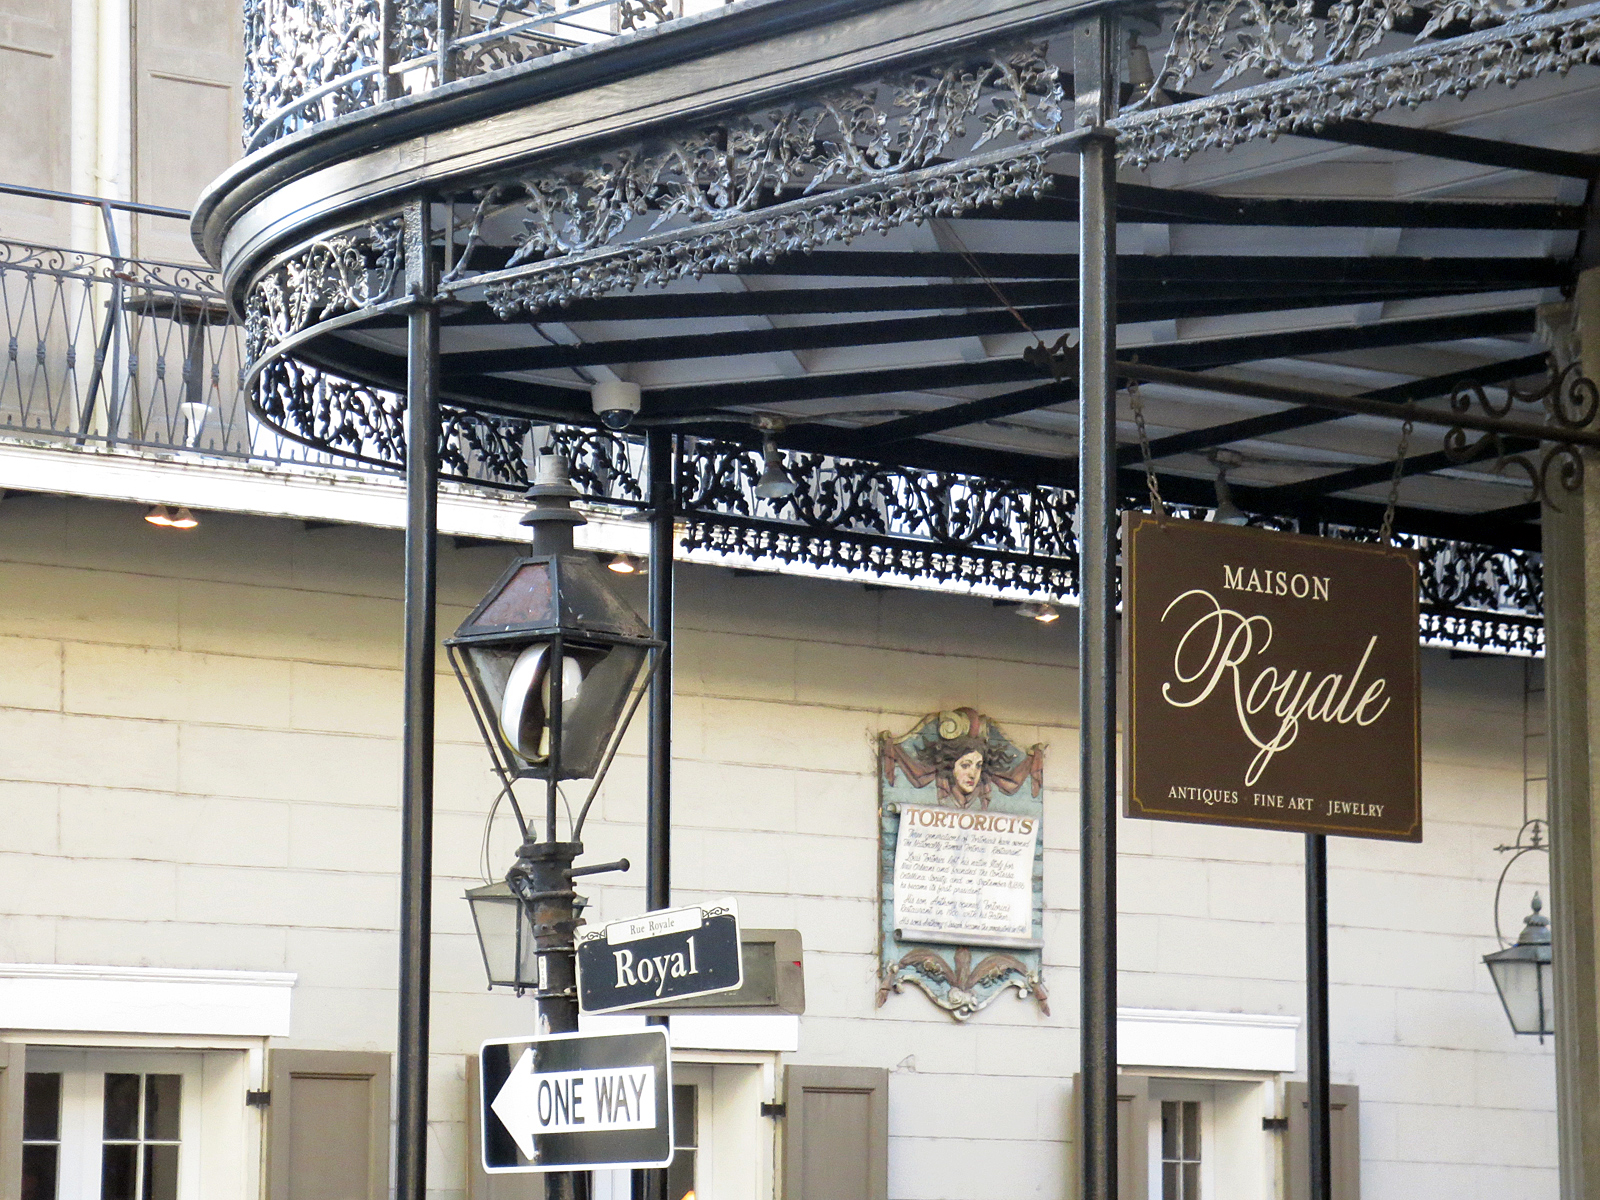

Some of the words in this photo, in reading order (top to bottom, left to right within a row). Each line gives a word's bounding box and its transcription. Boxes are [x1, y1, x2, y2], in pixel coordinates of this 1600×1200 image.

[1222, 565, 1331, 602] MAISON
[1160, 589, 1391, 787] Royale
[1168, 786, 1239, 806] ANTIQUES
[1253, 793, 1284, 808] FINE
[1288, 797, 1314, 811] ART
[1326, 800, 1385, 818] JEWELRY
[906, 808, 1035, 835] TORTORICI'S
[630, 923, 645, 935] Rue
[648, 918, 675, 931] Royale
[612, 936, 699, 997] Royal
[537, 1077, 585, 1127] ONE
[595, 1073, 646, 1124] WAY
